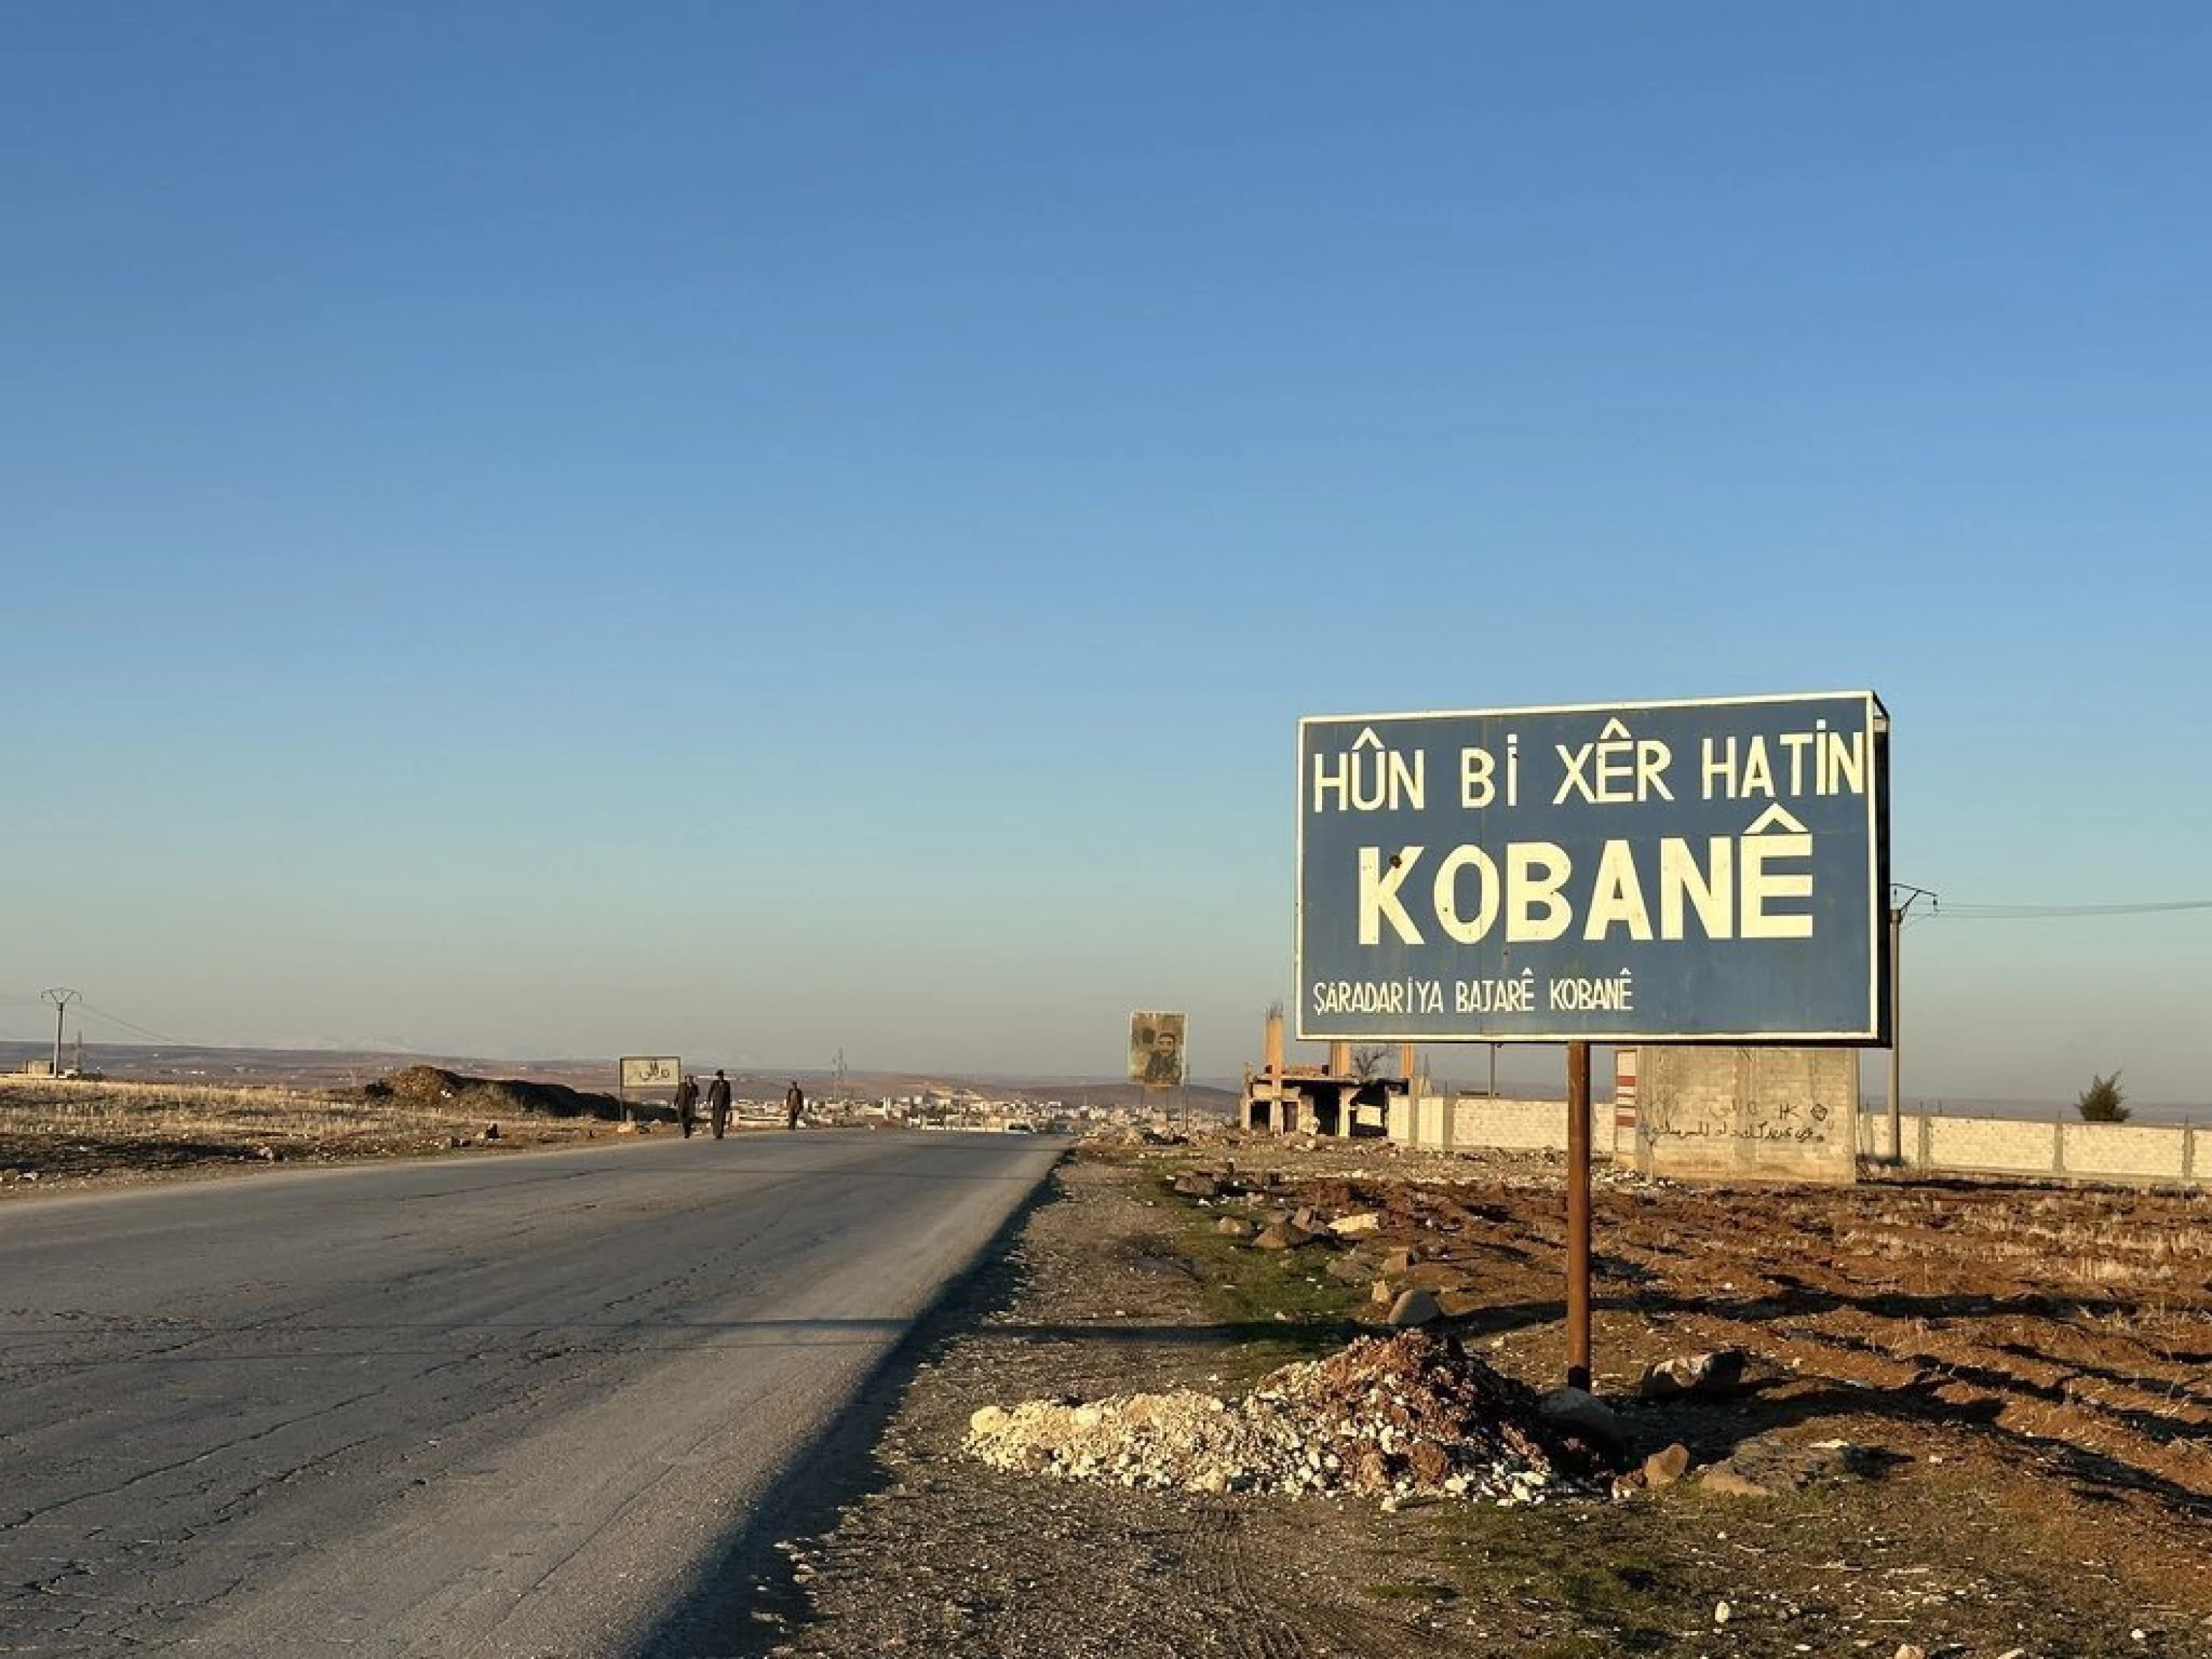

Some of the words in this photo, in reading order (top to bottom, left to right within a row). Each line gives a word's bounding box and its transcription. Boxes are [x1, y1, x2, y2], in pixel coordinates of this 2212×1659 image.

[1314, 727, 1425, 813] HÛN
[1552, 717, 1675, 804] XÊR
[1357, 802, 1814, 945] KOBANÊ
[1455, 967, 1535, 1014] BAJARÊ
[1550, 967, 1634, 1012] KOBANÊ
